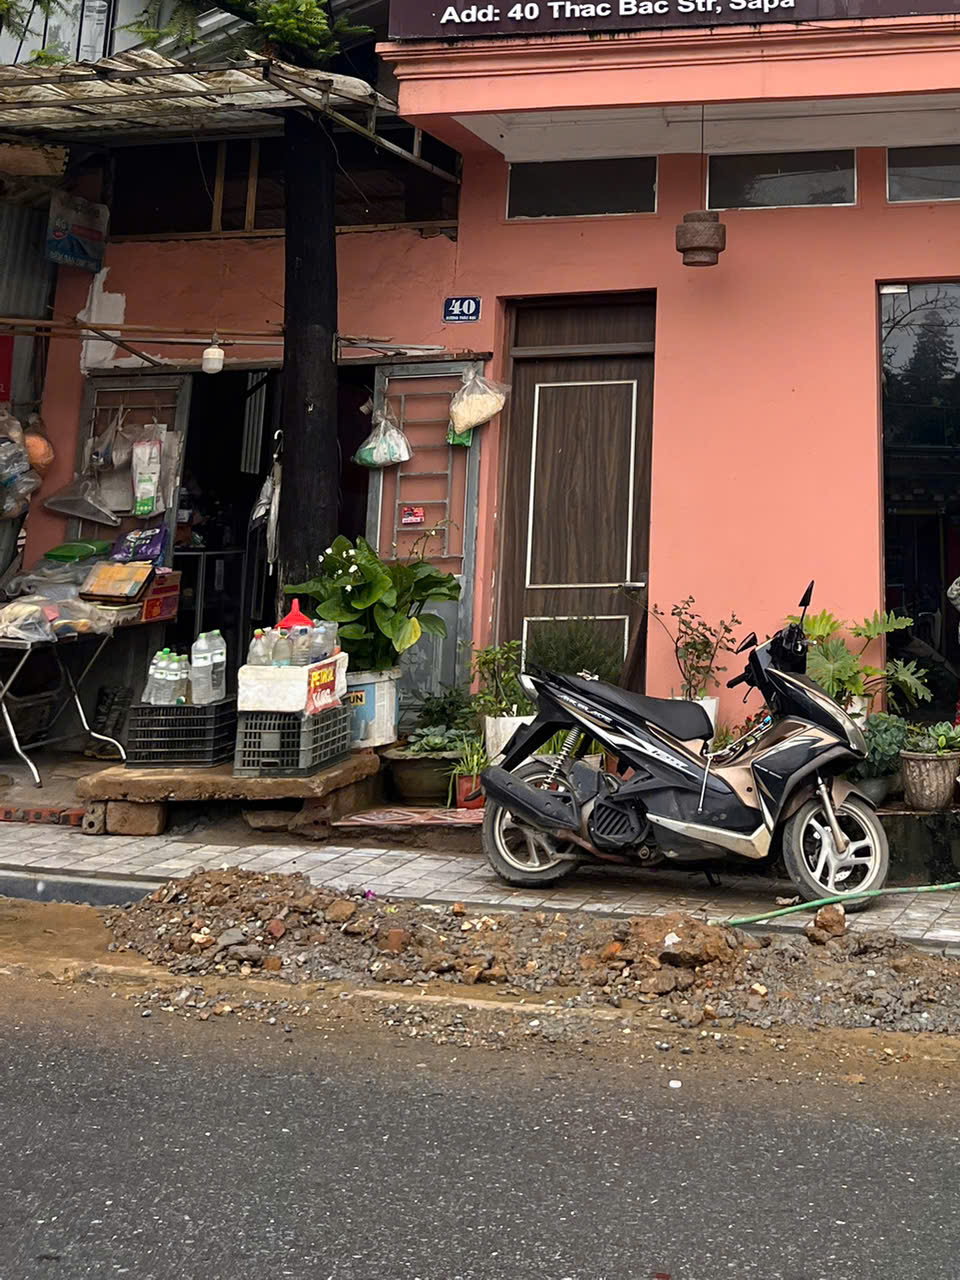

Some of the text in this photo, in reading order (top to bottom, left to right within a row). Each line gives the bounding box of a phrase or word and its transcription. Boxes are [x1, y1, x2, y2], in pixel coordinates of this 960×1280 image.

[440, 4, 501, 24] Add:
[507, 2, 540, 20] 40
[547, 1, 612, 19] Thac
[448, 299, 477, 315] 40
